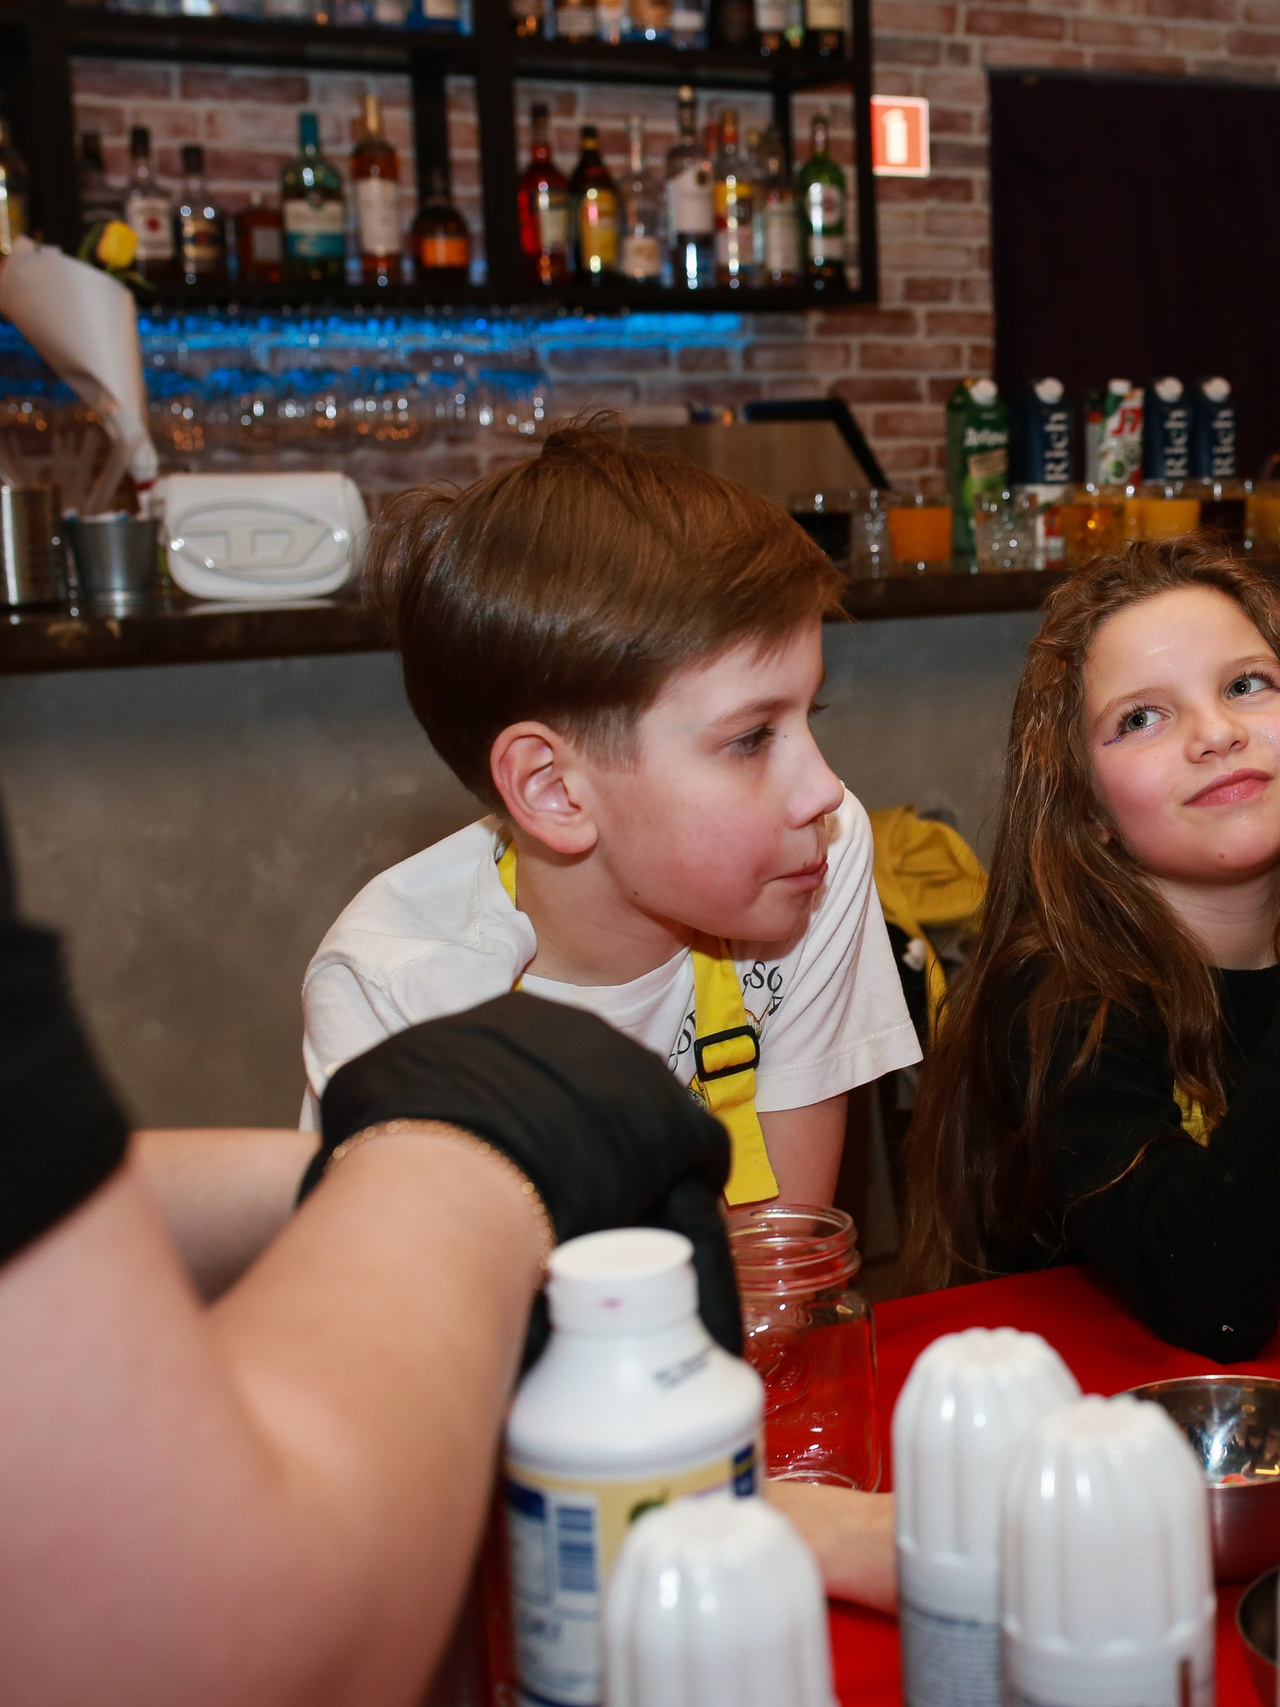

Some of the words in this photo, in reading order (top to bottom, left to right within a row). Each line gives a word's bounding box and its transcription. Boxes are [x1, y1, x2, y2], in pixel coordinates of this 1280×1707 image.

[1043, 410, 1070, 482] Rich
[1164, 407, 1189, 478] Rich
[1212, 407, 1236, 477] Rich
